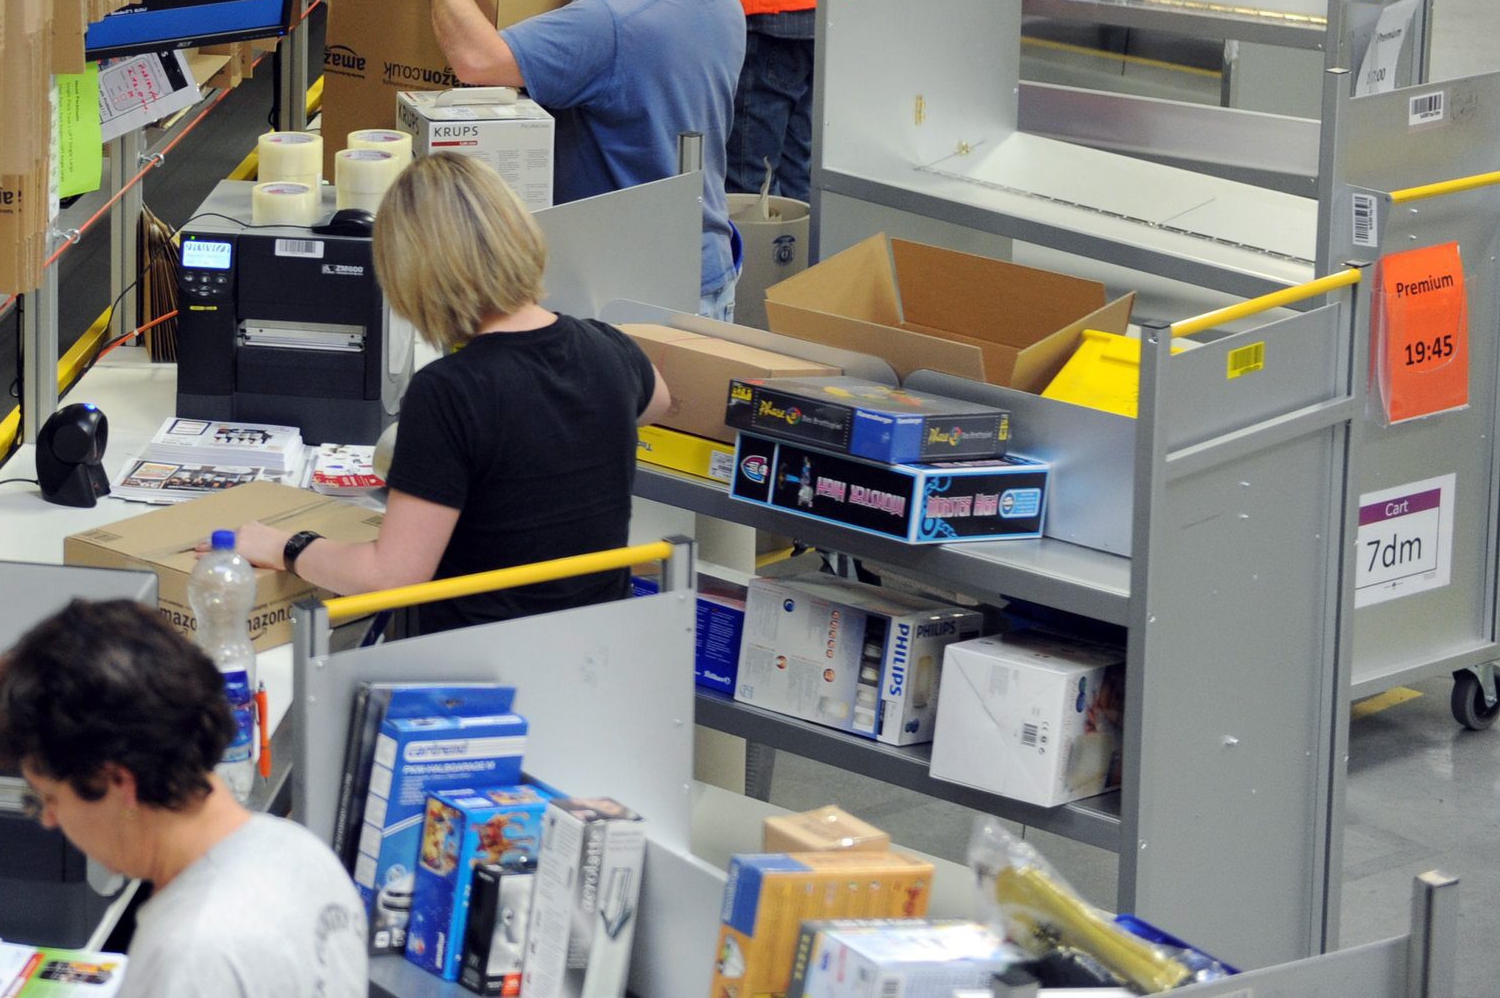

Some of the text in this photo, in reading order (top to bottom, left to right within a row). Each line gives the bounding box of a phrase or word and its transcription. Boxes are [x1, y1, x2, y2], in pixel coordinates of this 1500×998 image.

[433, 125, 480, 138] KRUPS
[1396, 271, 1455, 300] Premium
[1404, 334, 1454, 367] 19:45
[815, 474, 847, 505] HIGH
[925, 493, 1000, 520] MONSTER HIGH
[1384, 499, 1409, 518] Cart
[1366, 532, 1423, 573] 7dm
[916, 619, 957, 640] PHILIPS
[890, 622, 911, 697] PHILIPS
